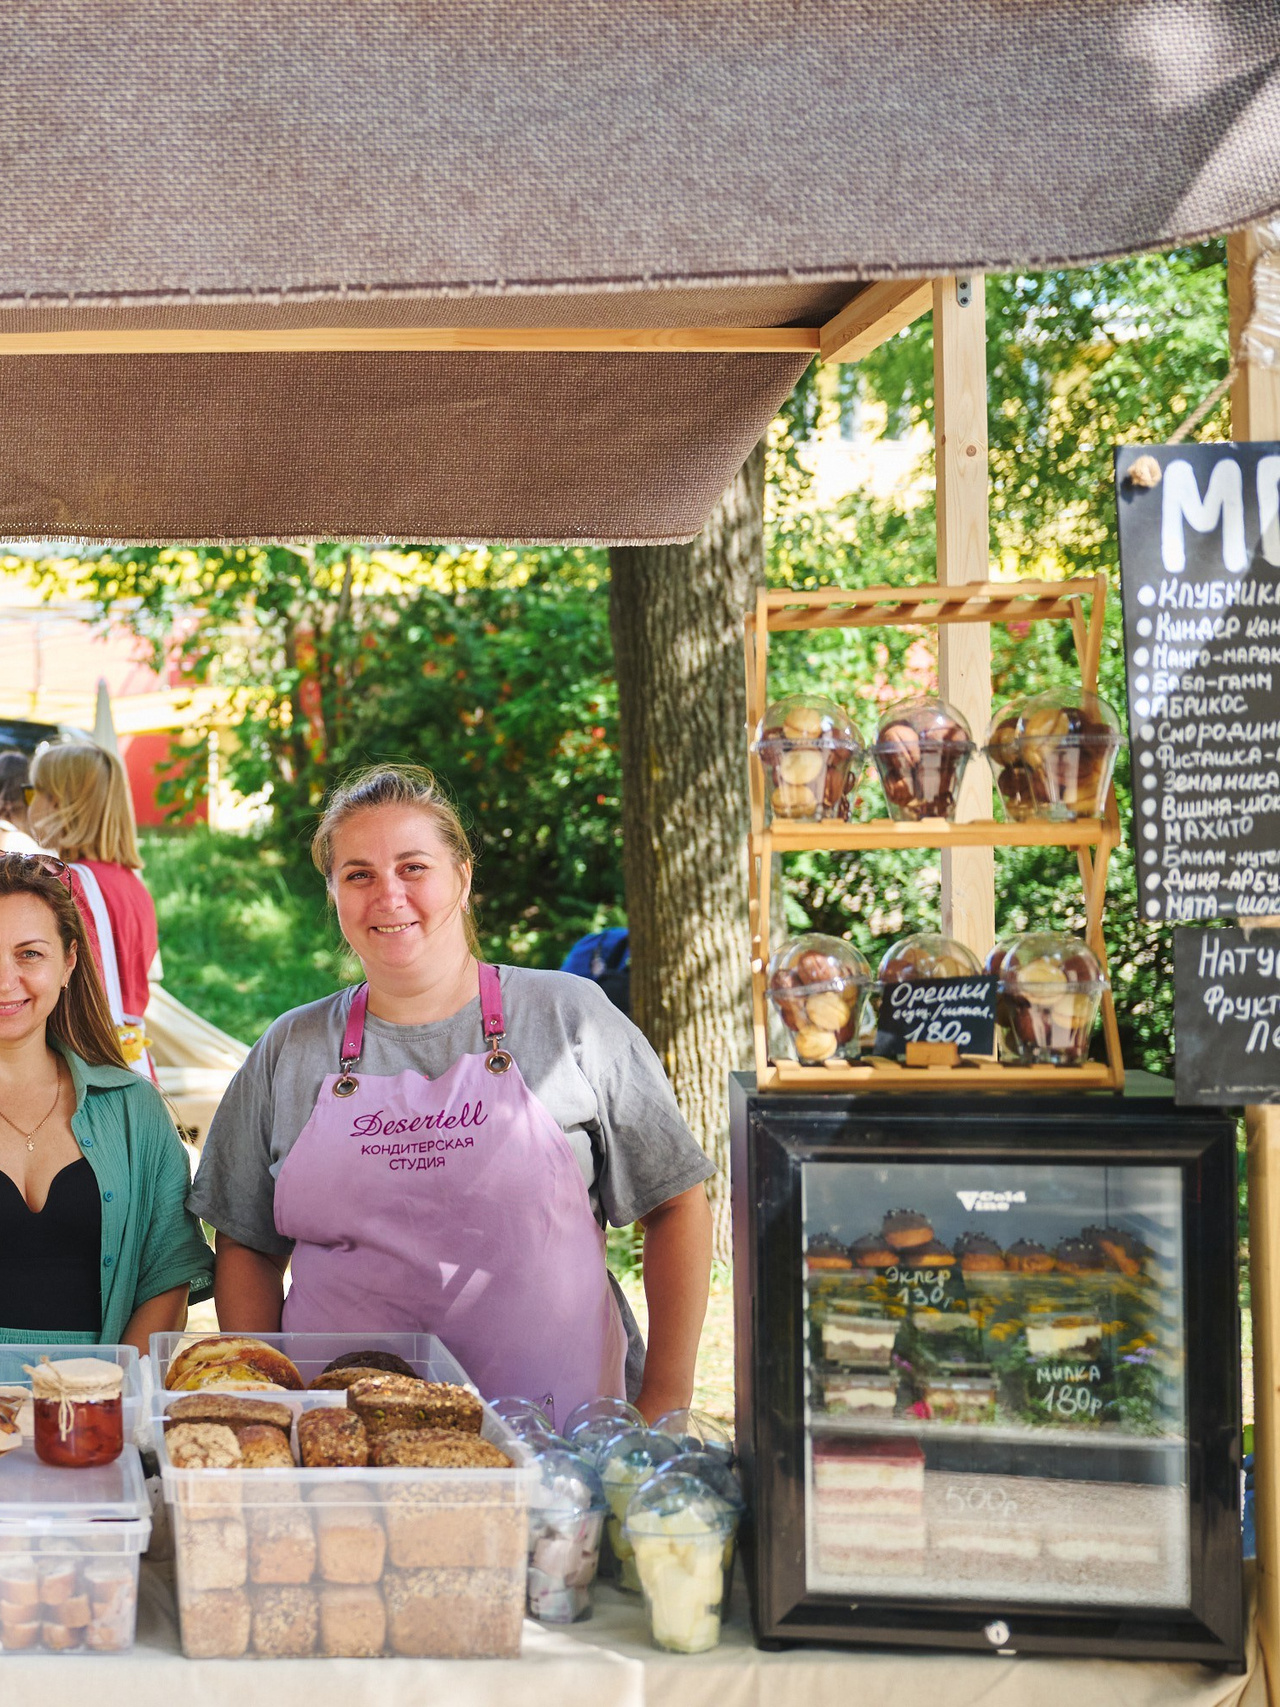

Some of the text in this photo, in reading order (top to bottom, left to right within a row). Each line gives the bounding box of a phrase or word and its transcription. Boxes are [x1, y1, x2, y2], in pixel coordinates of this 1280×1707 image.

[350, 1100, 488, 1137] Desertell
[361, 1137, 474, 1155] КОНДИТЕРСКАЯ
[389, 1156, 446, 1171] СТУДИЯ
